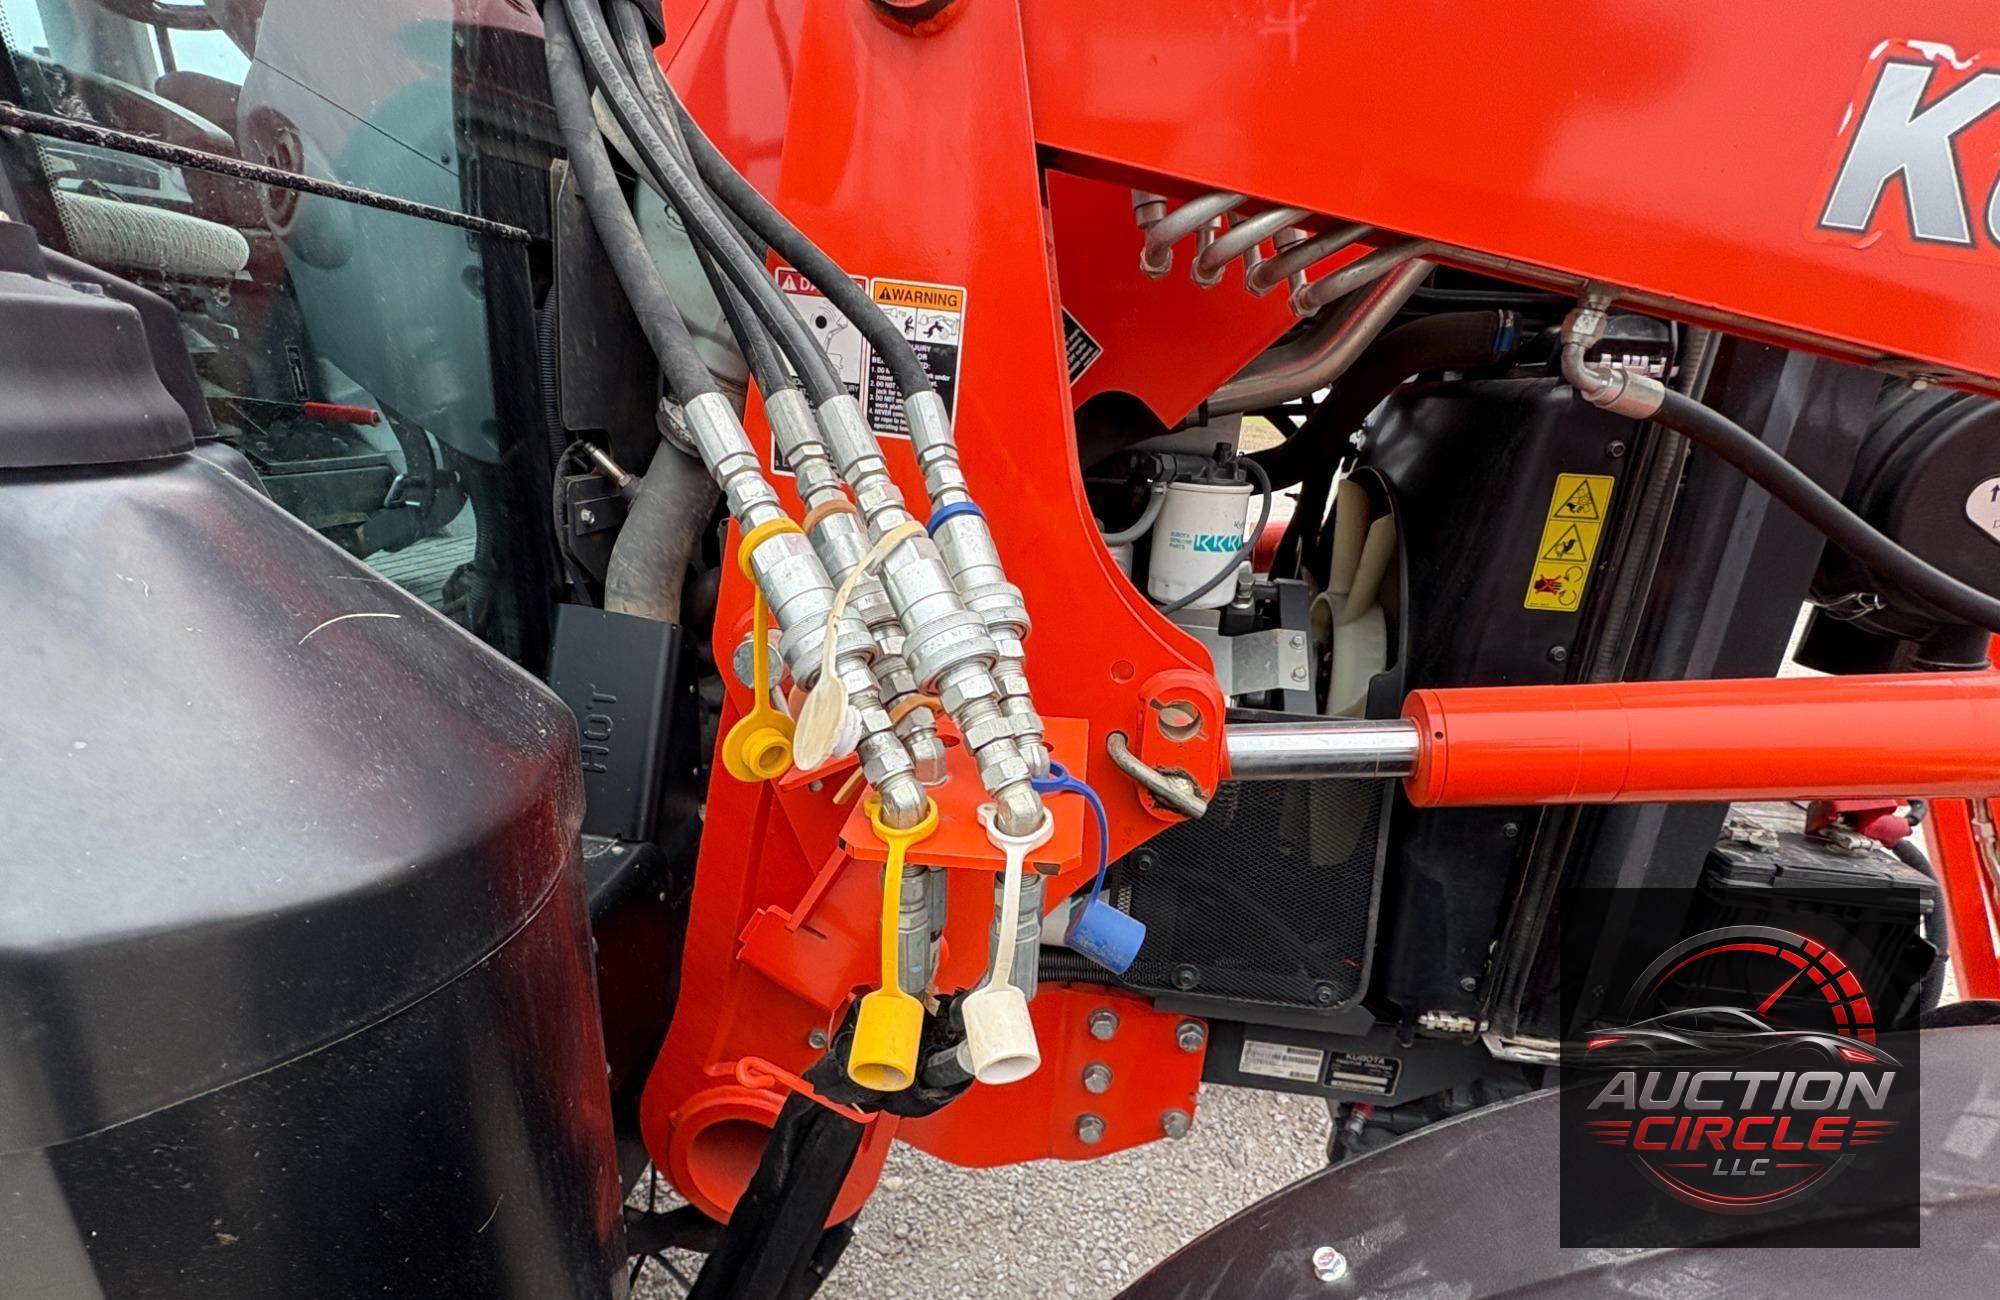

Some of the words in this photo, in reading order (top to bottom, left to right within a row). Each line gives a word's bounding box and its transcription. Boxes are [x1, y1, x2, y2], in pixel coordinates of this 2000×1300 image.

[1816, 57, 2000, 250] K
[893, 289, 957, 307] WARNING
[581, 683, 617, 774] HOT
